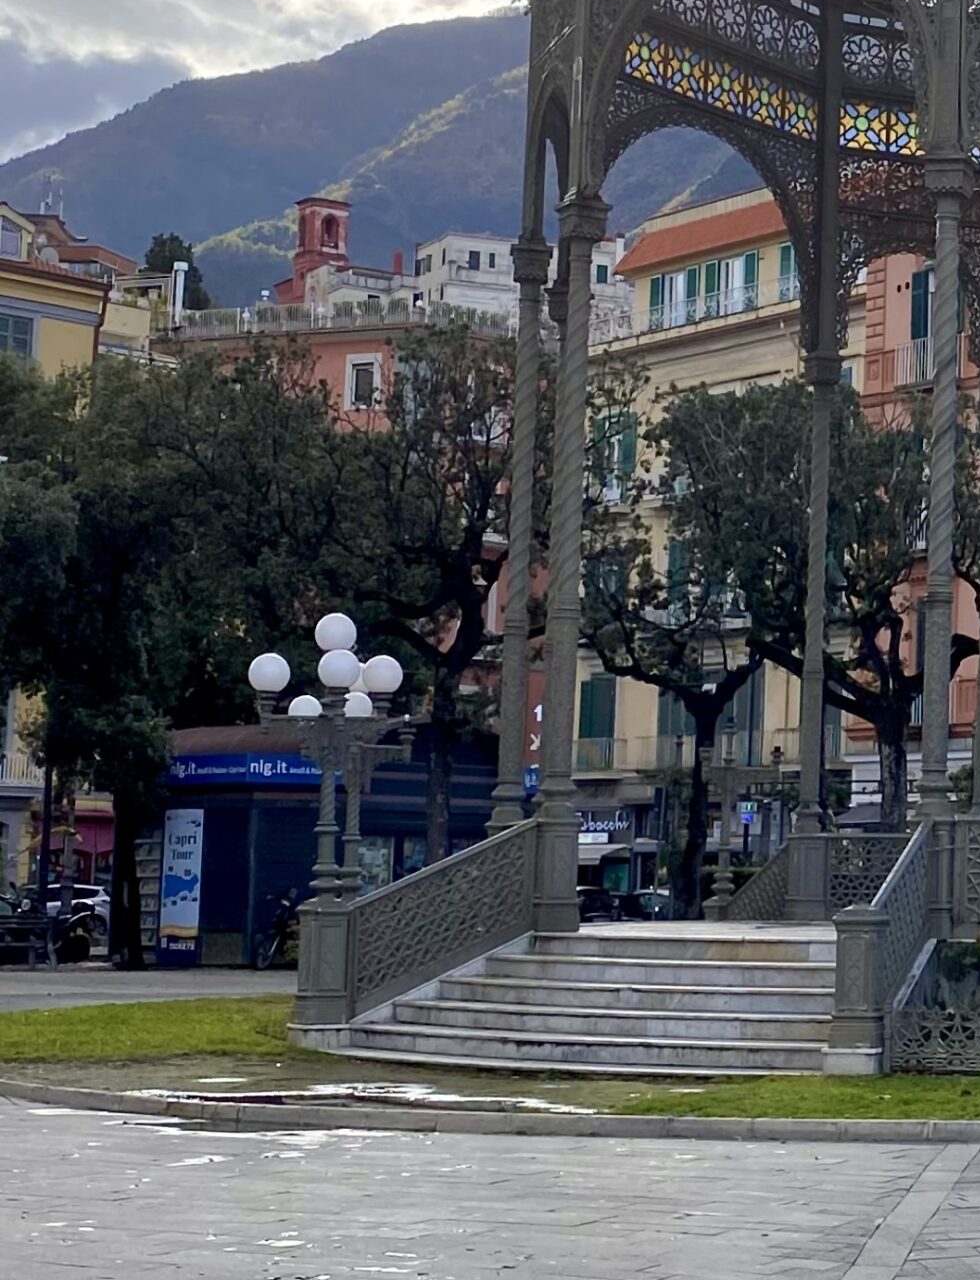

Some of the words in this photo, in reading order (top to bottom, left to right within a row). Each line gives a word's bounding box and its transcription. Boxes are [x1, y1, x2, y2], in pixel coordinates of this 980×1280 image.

[250, 759, 288, 777] nlg.it
[168, 831, 198, 848] Capri
[170, 848, 195, 861] Tour
